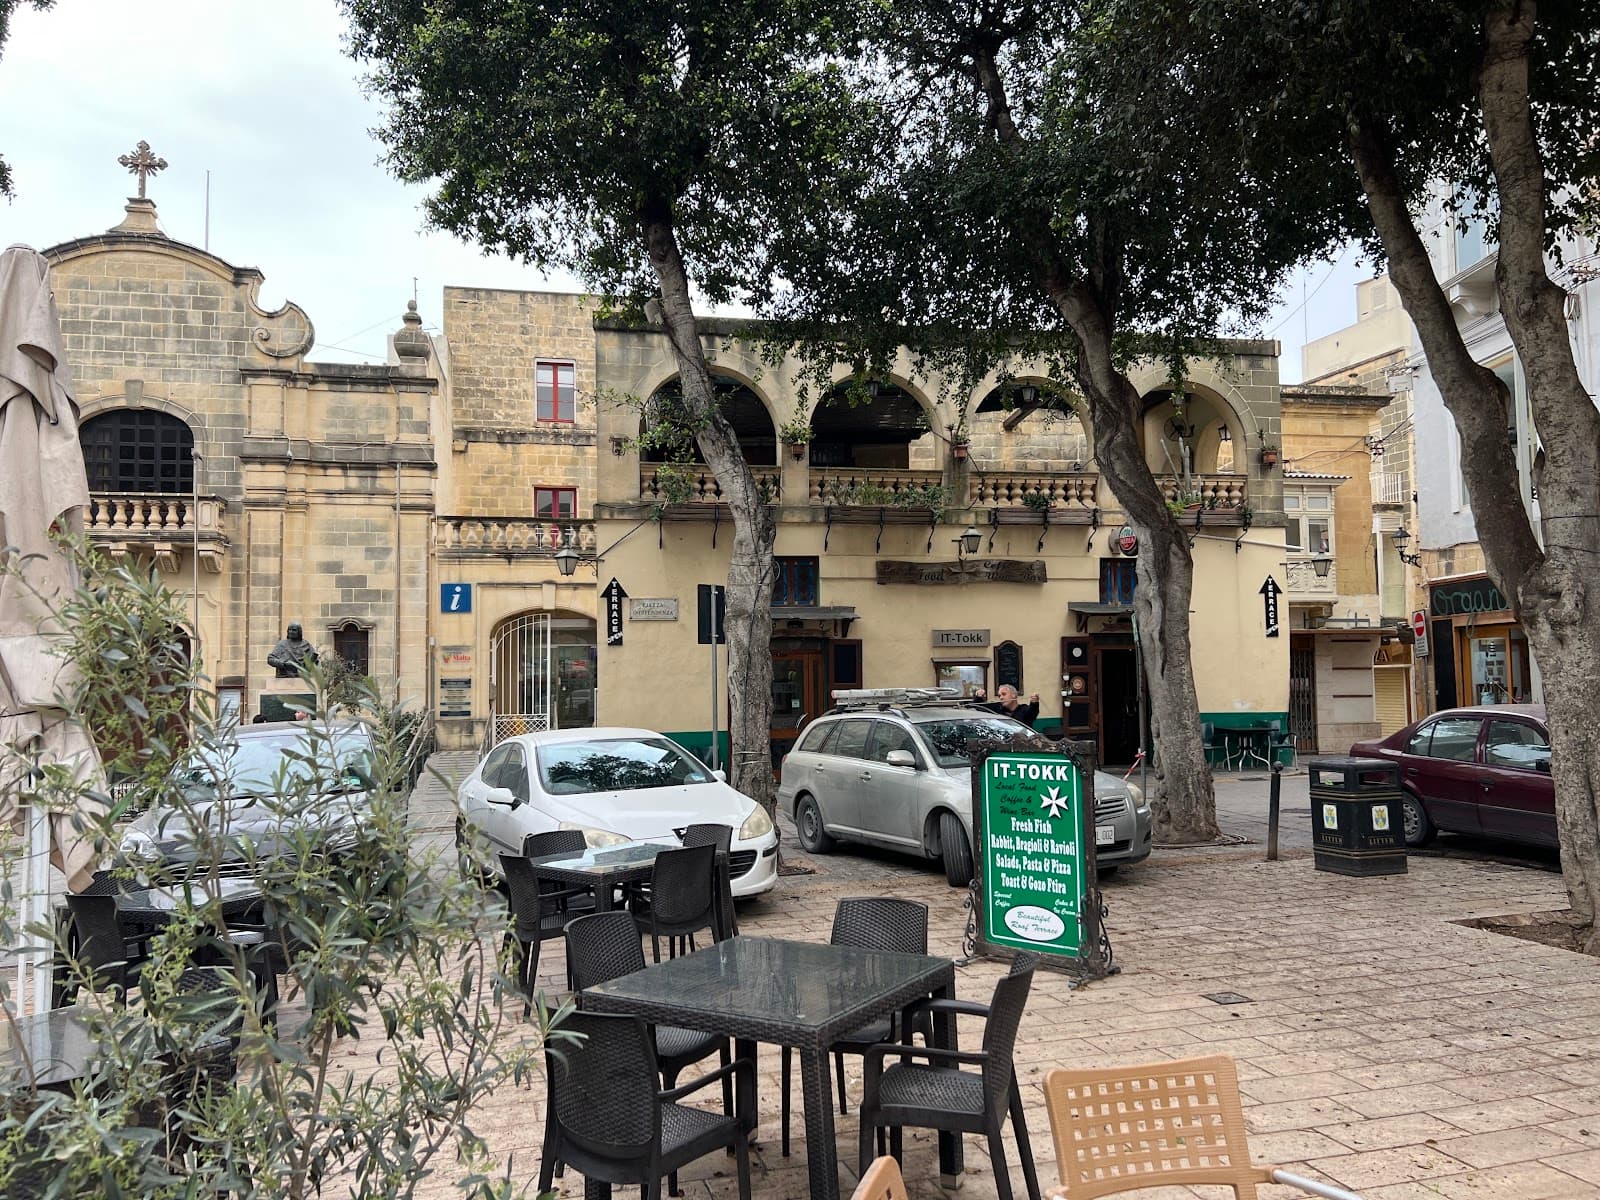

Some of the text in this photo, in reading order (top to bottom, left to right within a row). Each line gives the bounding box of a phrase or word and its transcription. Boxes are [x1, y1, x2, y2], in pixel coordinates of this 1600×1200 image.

[611, 581, 619, 633] TERRACE
[1433, 588, 1509, 639] Organ
[940, 633, 983, 644] IT-Tokk
[993, 763, 1069, 781] IT-TOKK
[1000, 793, 1023, 805] Coffee
[1010, 817, 1052, 834] Fresh Fish
[991, 833, 1076, 856] Rabbit, Bragioli & Ravioli
[1320, 834, 1343, 844] LITTER
[1369, 837, 1395, 846] LITTER
[995, 853, 1071, 875] Salads, Pasta & Pizza
[1001, 872, 1066, 894] Toast & Gozo Ftira
[1017, 911, 1051, 923] Beautiful
[1031, 924, 1058, 935] Terrace
